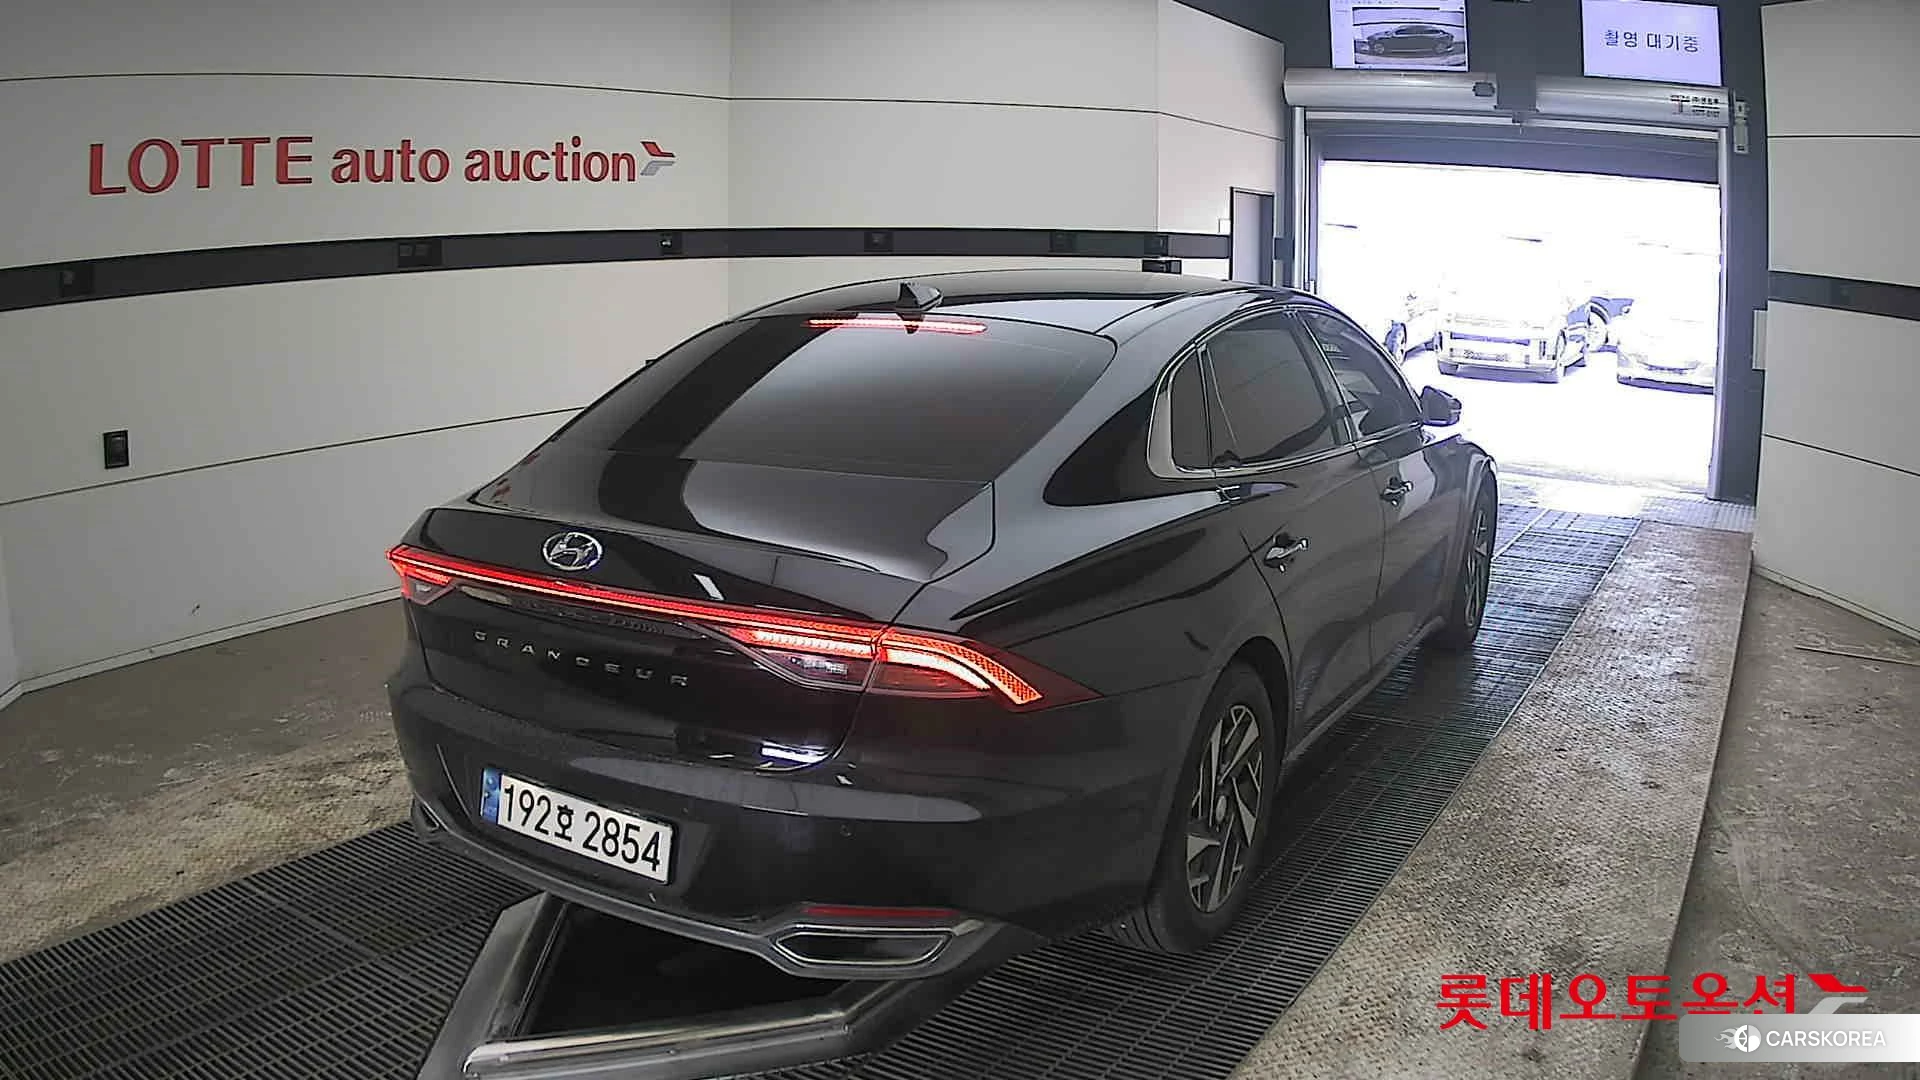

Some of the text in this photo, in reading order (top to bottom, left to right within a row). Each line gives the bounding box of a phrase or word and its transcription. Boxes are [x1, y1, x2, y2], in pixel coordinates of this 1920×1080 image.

[1604, 29, 1698, 53] 촬영 대기중
[89, 135, 637, 195] LOTTE auto auction
[503, 784, 661, 873] 192호 2854
